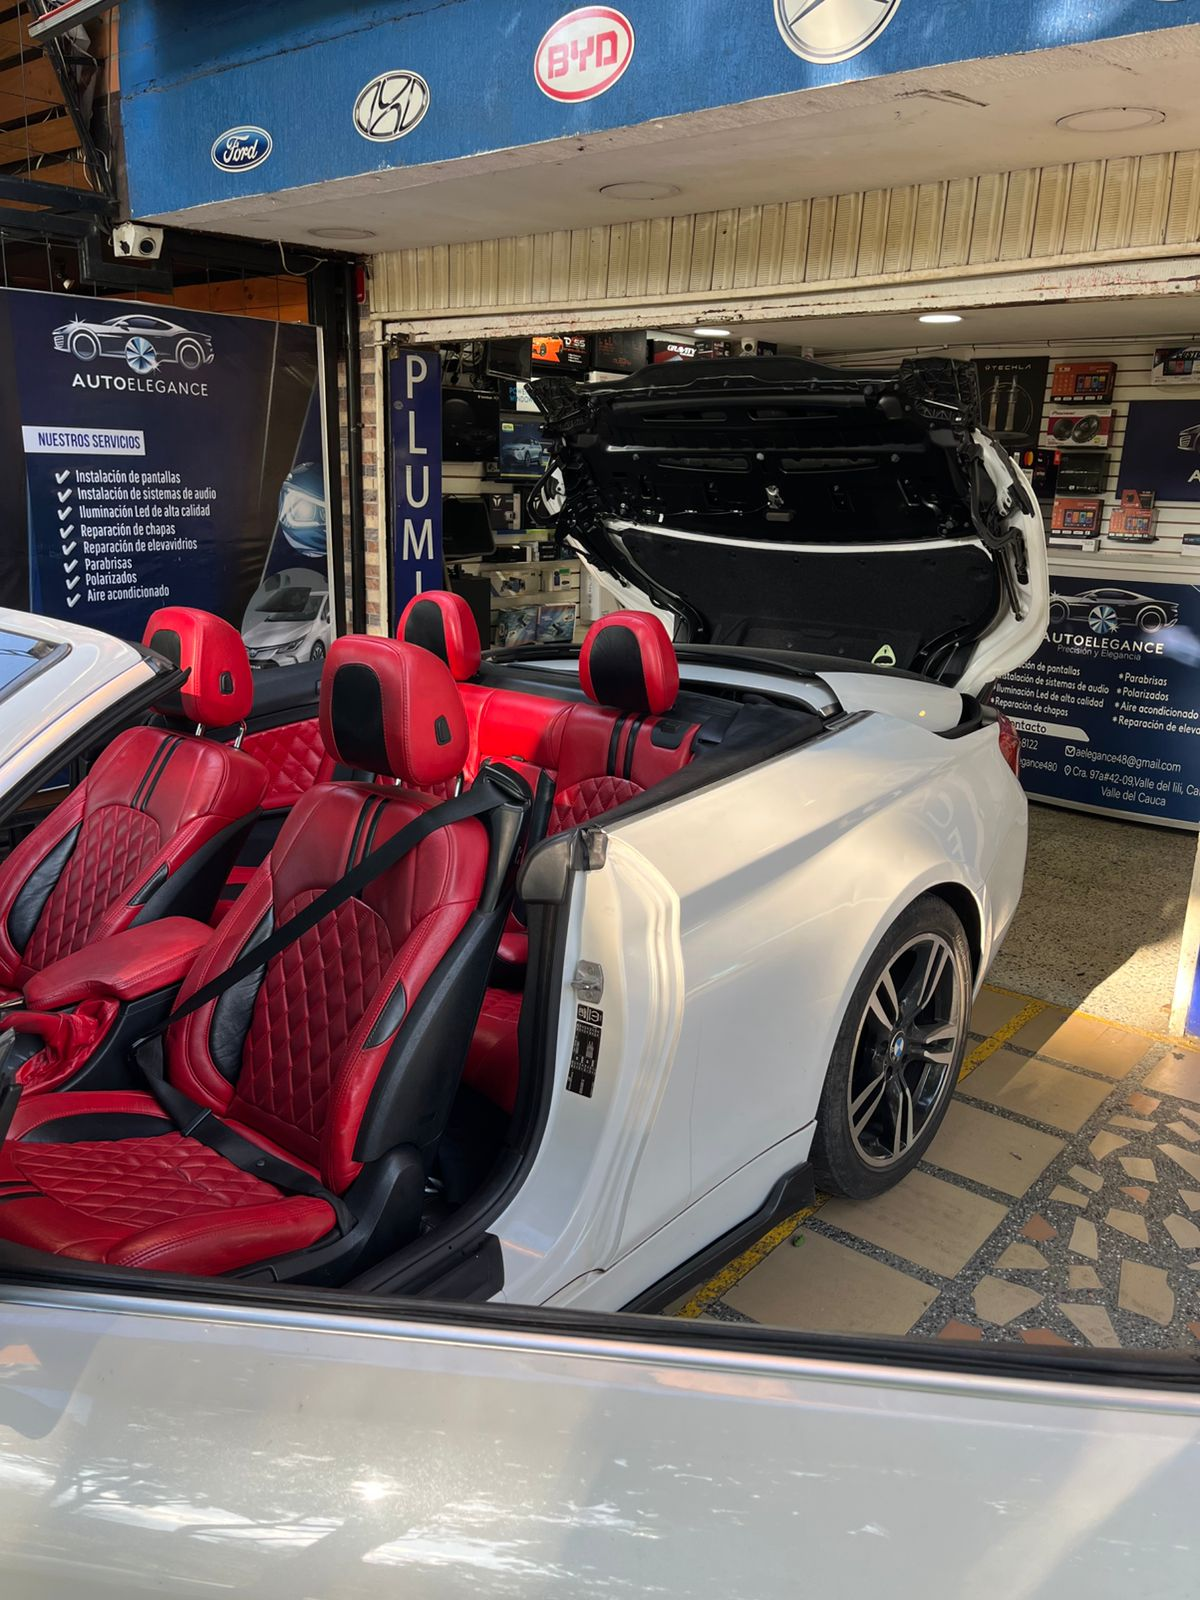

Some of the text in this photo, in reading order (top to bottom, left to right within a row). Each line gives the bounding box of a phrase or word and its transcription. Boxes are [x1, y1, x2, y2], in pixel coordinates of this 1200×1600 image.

[548, 30, 617, 79] BYD
[223, 136, 258, 163] Ford
[72, 373, 208, 396] AUTOELEGANCE
[38, 432, 141, 449] NUESTROS SERVICIOS
[76, 470, 181, 486] Instalación de pantallas
[77, 487, 217, 500] Instalación de sistemas de audio
[79, 504, 211, 518] Iluminación Led de alta calidad
[80, 523, 176, 539] Reparación de chapas
[83, 537, 198, 556] Reparación de elevavidrios
[84, 557, 133, 571] Parabrisas
[85, 571, 138, 586] Polarizados
[87, 584, 170, 602] Aire acondicionado
[1057, 644, 1092, 655] Precisión
[1101, 649, 1141, 661] Elegancia
[1036, 662, 1046, 671] de
[1046, 665, 1080, 676] pantallas
[1035, 676, 1044, 685] de
[1045, 678, 1076, 690] sistemas
[1077, 681, 1087, 691] de
[1088, 683, 1110, 694] audio
[1124, 672, 1168, 687] Parabrisas
[996, 683, 1104, 708] Iluminación Led de alta calidad
[1122, 686, 1169, 701] Polarizados
[994, 696, 1069, 718] Reparación de chapas
[1120, 701, 1199, 720] Aire acondicionado
[1011, 720, 1047, 733] ontacto
[1118, 715, 1200, 735] Reparación de eleva
[1075, 748, 1181, 773] aelegance48@gmail.com
[1101, 786, 1166, 806] Valle del Cauca
[1156, 780, 1171, 792] del
[1186, 784, 1200, 797] Ca
